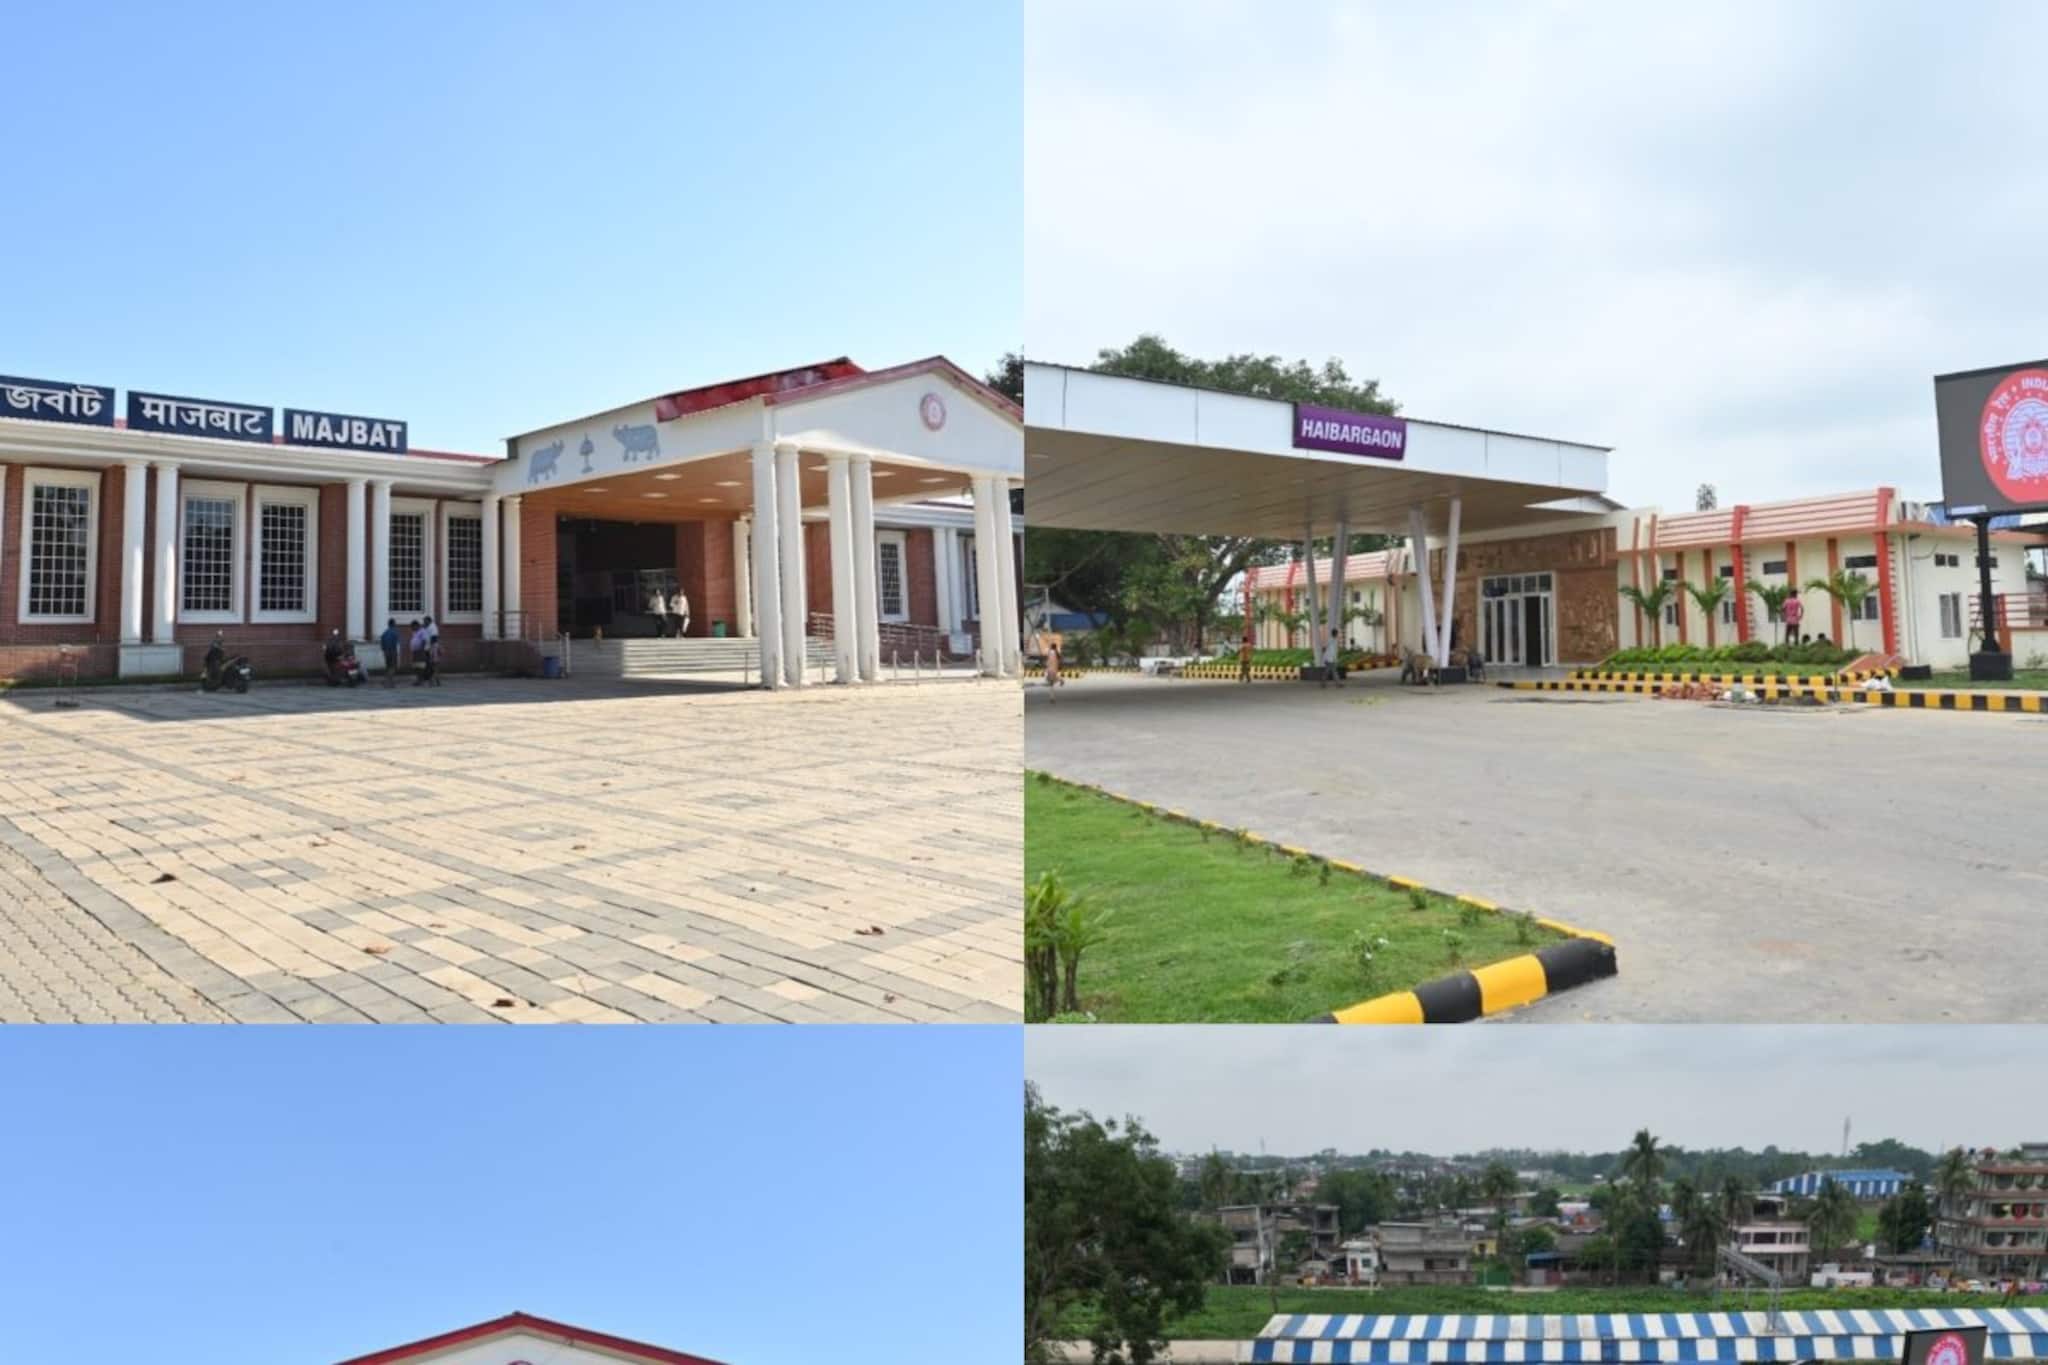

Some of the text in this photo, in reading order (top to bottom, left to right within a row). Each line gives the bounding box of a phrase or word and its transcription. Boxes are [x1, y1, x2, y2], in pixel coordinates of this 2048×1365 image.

[139, 397, 266, 434] माजबाट
[293, 413, 403, 449] MAJBAT
[1301, 419, 1403, 449] HAIBARGAON
